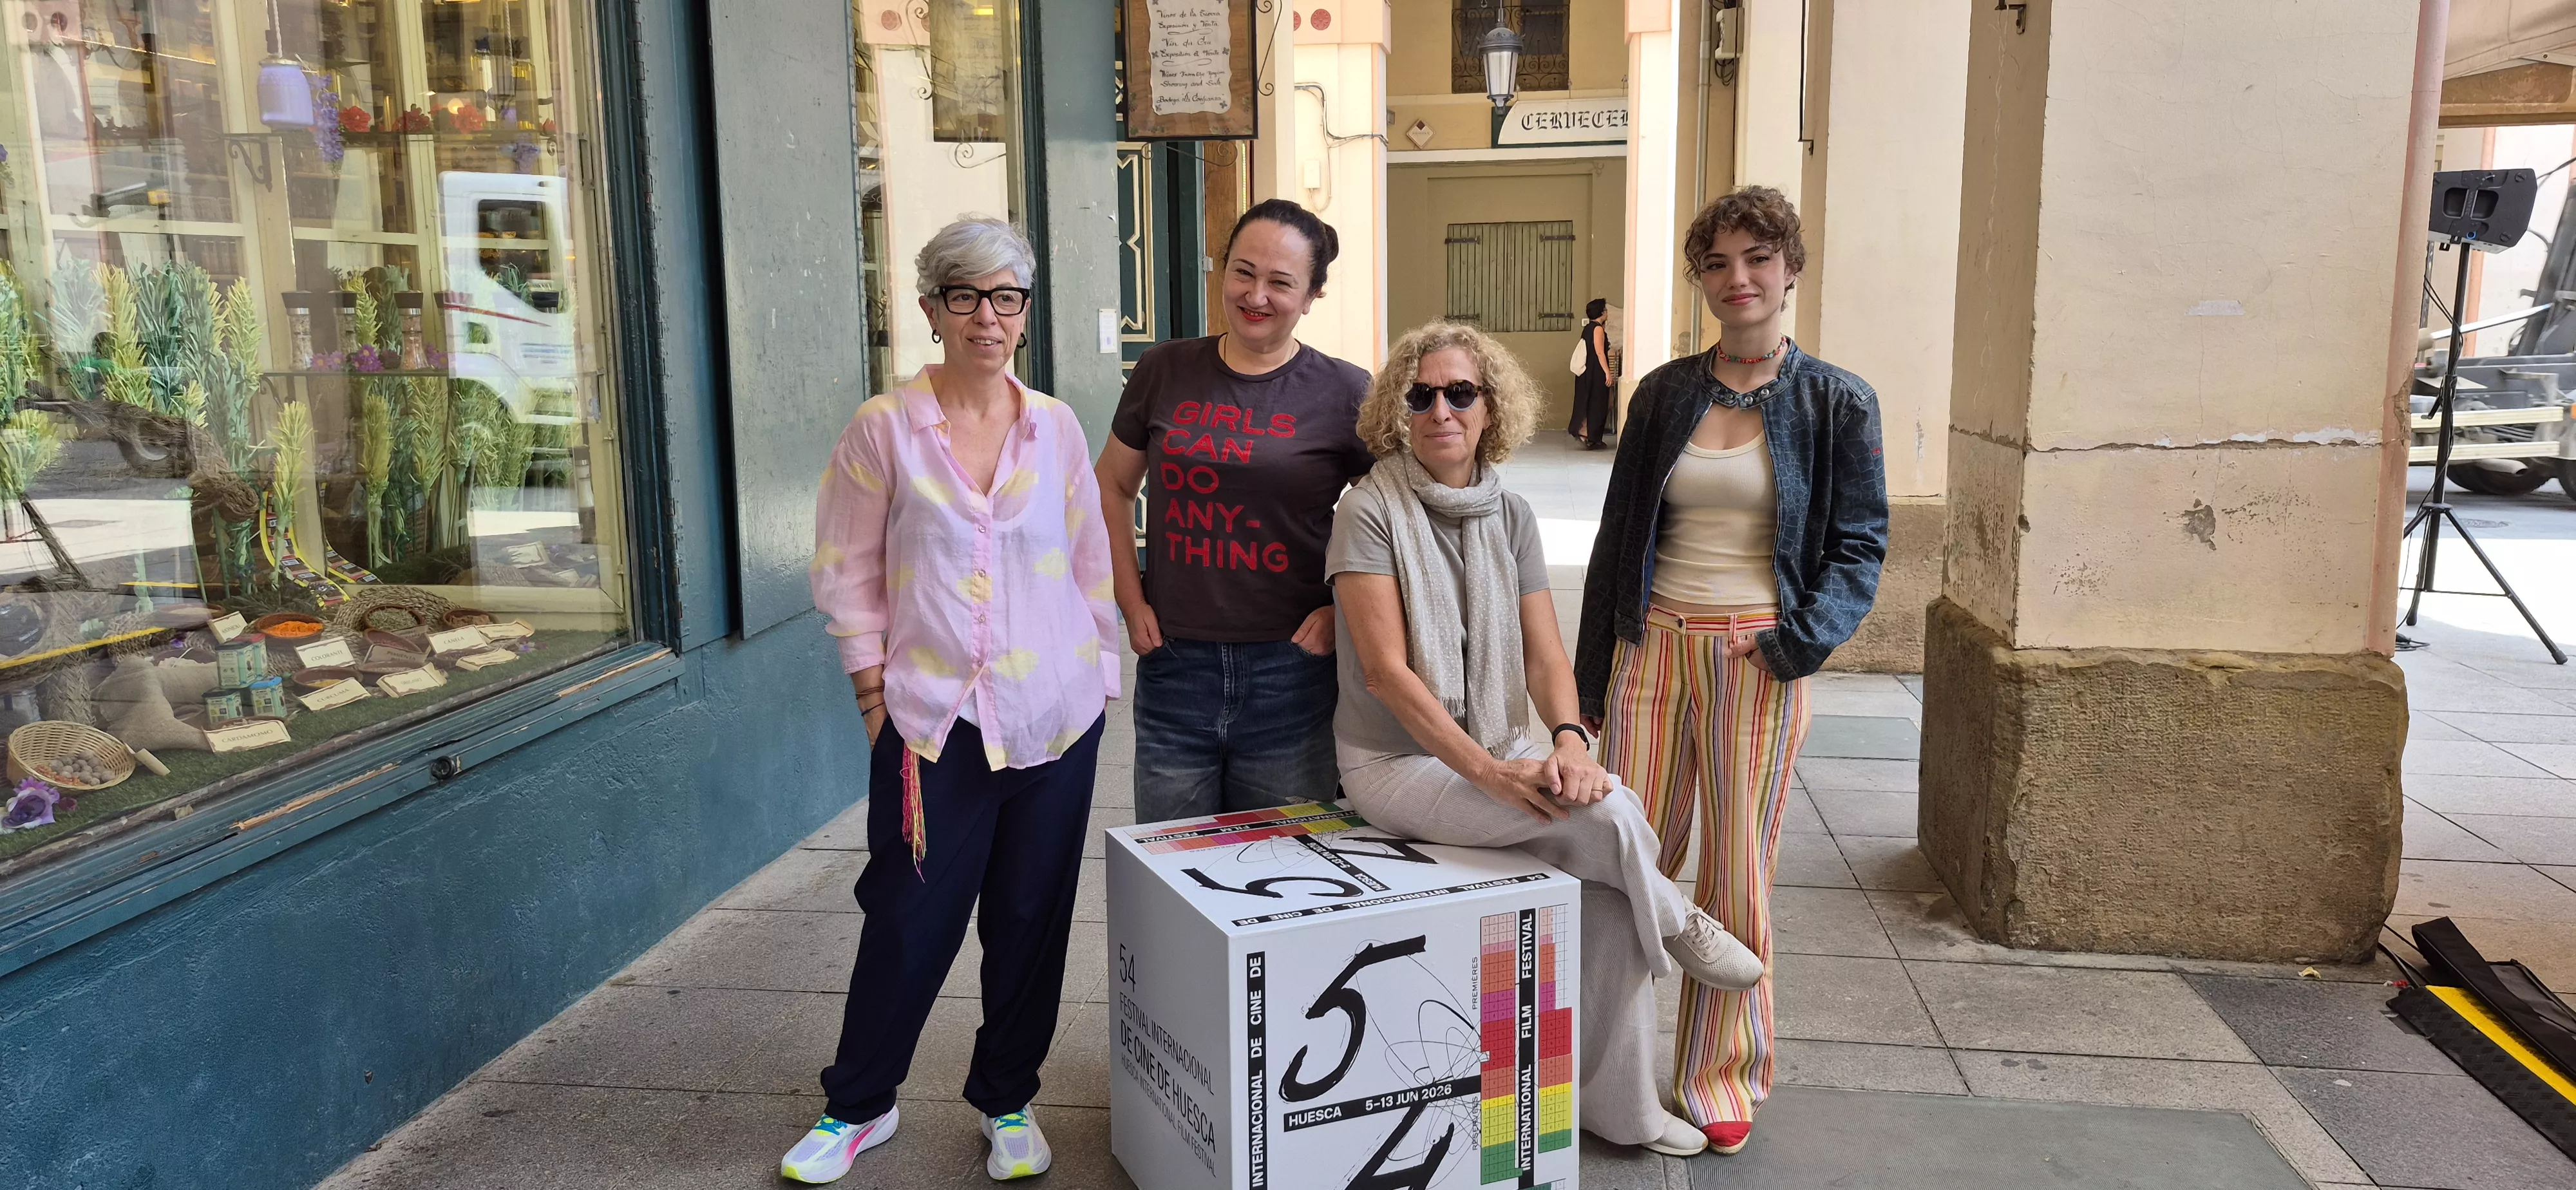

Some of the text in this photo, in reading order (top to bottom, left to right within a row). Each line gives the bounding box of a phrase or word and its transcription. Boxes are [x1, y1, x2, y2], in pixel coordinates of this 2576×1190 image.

[1157, 10, 1176, 18] Vinos
[1189, 8, 1197, 17] la
[1161, 38, 1179, 47] Vin
[1182, 39, 1193, 48] du
[1159, 49, 1191, 59] Exposition
[1206, 77, 1221, 86] Sale
[1157, 95, 1180, 105] Bodega
[1173, 401, 1296, 438] GIRLS
[1162, 429, 1254, 463] CAN
[1161, 462, 1219, 494] DO
[1165, 498, 1261, 533] ANY-
[1165, 531, 1289, 572] THING
[316, 688, 350, 703] CURCUMA
[222, 729, 273, 744] CARDAMOMO
[1139, 831, 1198, 843] FESTIVAL
[1220, 824, 1251, 833] FILM
[1354, 873, 1385, 891] HUESCA
[1461, 878, 1520, 891] FESTIVAL
[1343, 888, 1451, 909] INTERNACIONAL
[1270, 911, 1303, 921] CINE
[1312, 906, 1334, 914] DE
[1237, 918, 1259, 926] DE
[1119, 943, 1136, 992] 54
[1120, 991, 1215, 1096] FESTIVAL INTERNACIONAL
[1520, 912, 1532, 1171] INTERNATIONAL FILM FESTIVAL
[1249, 956, 1264, 1187] INTERNACIONAL DE CINE DE
[1121, 1018, 1216, 1153] DE CINE DE HUESCA
[1289, 1105, 1343, 1128] HUESCA
[1396, 1090, 1419, 1106] JUN
[1421, 1083, 1453, 1101] 2026
[1121, 1052, 1217, 1178] HUESCA INTERNATIONAL FILM FESTIVAL
